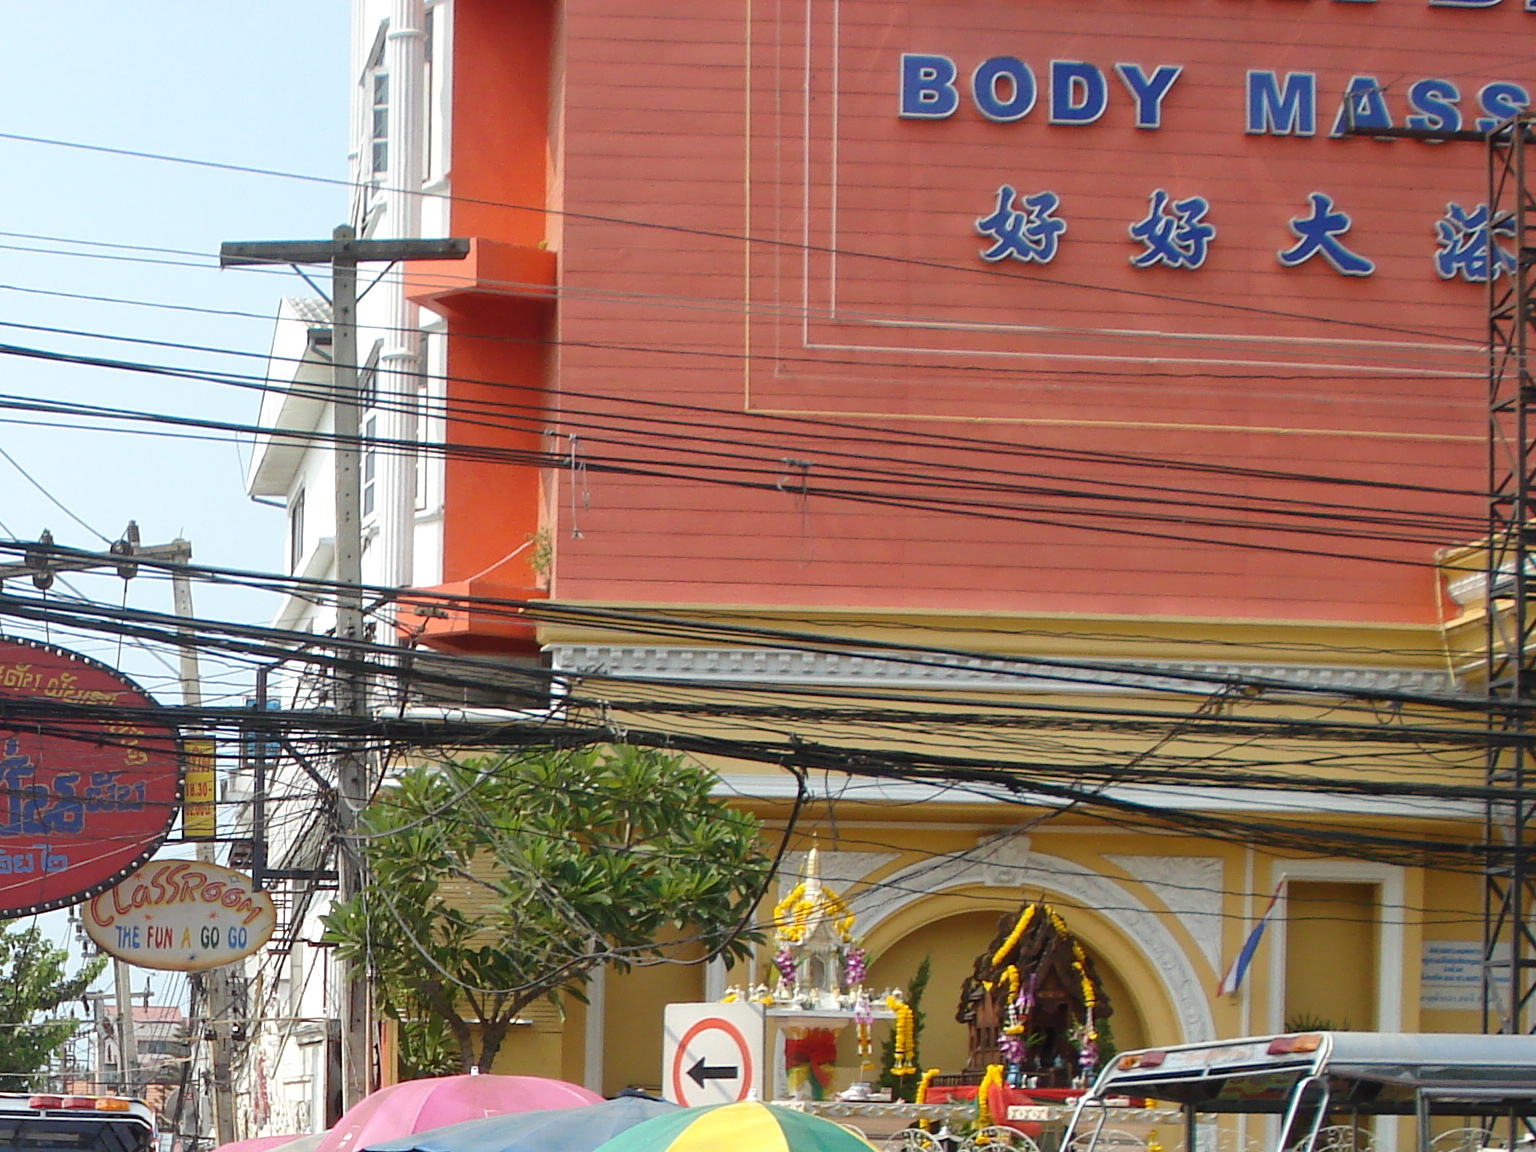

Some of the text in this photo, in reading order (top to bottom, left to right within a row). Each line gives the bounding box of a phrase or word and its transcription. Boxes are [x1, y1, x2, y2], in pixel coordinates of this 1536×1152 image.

[897, 53, 1183, 130] BODY
[115, 925, 248, 950] THE FUN A GO GO
